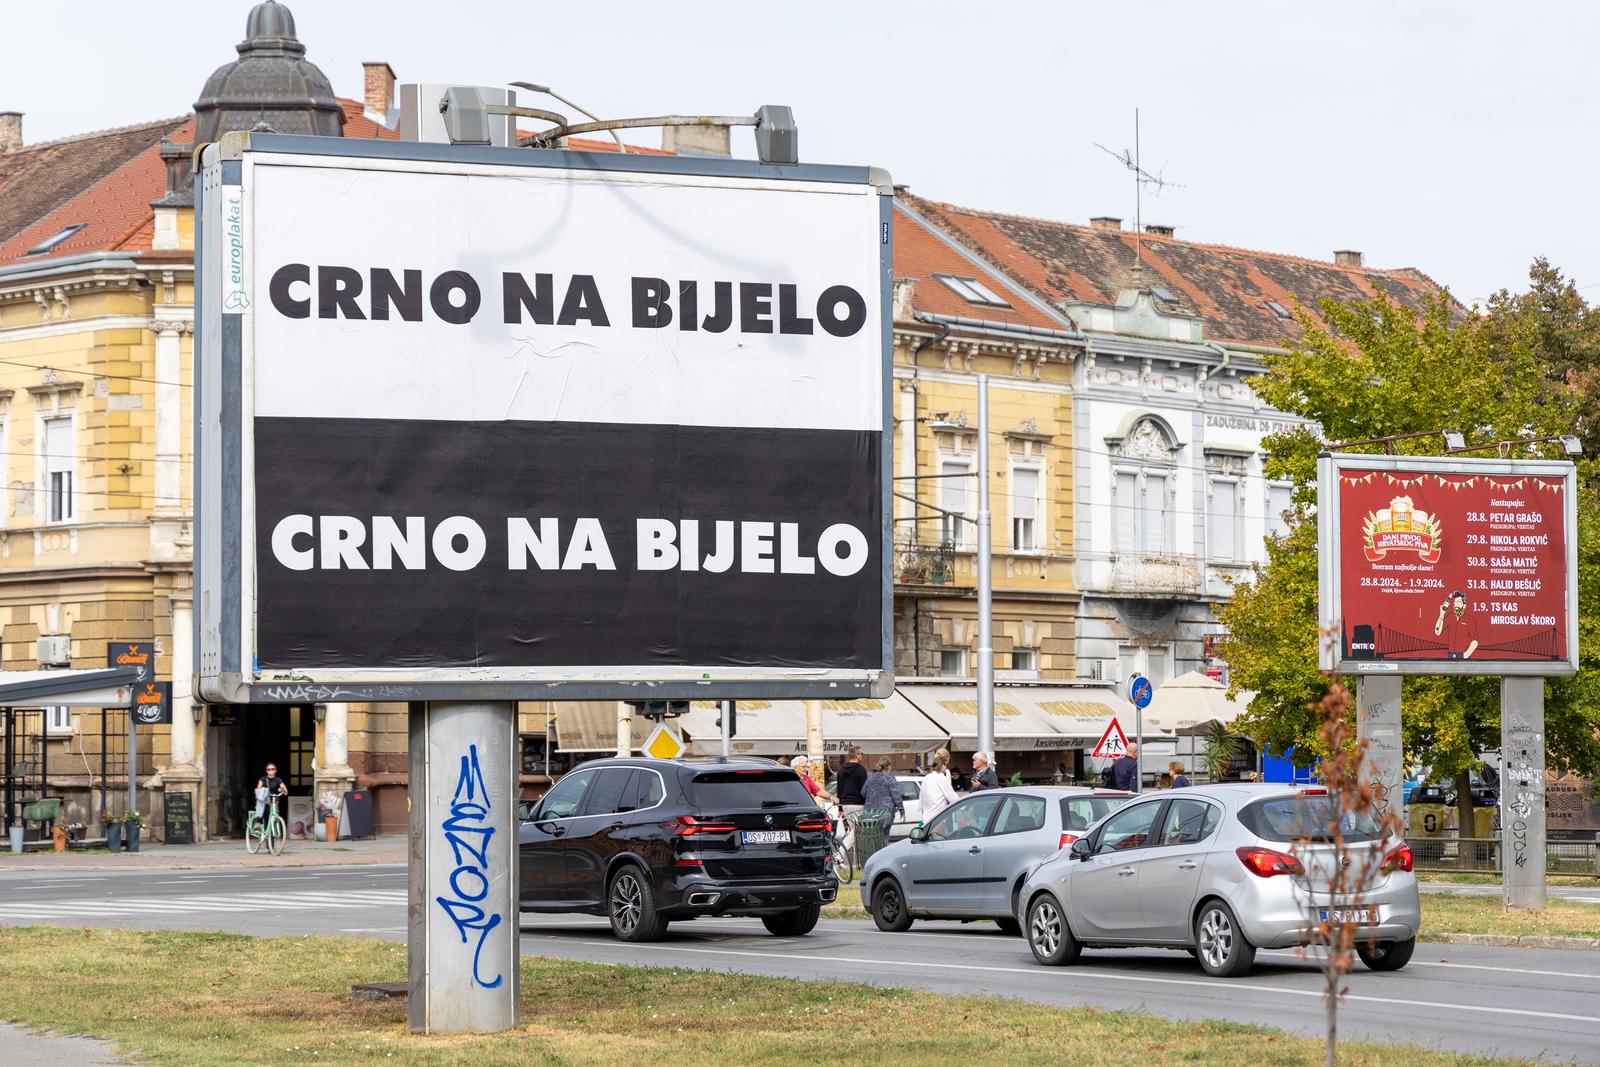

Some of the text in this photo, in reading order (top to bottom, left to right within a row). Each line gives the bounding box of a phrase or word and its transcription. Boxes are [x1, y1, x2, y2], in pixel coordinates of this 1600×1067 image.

[227, 198, 243, 284] europlakat
[269, 263, 867, 337] CRNO NA BIJELO
[1490, 499, 1525, 508] Nastupaju:
[1466, 512, 1542, 522] 28.8. PETAR GRAŠO
[271, 514, 869, 576] CRNO NA BIJELO
[1467, 534, 1548, 545] 29.8. NIKOLA ROKVIĆ
[1467, 556, 1538, 567] 30.8. SAŠA MATIĆ
[1360, 578, 1402, 587] 28.8.2024.
[1410, 579, 1445, 588] 1.9.2024.
[1467, 579, 1541, 590] 31.8. HALID BEŠLIĆ
[1473, 602, 1518, 611] 1.9. TS KAS
[1491, 614, 1555, 625] MIROSLAV ŠKORO
[795, 741, 838, 752] Amdam
[1034, 738, 1084, 749] Amsterdam Pub
[763, 831, 789, 841] 207-PL
